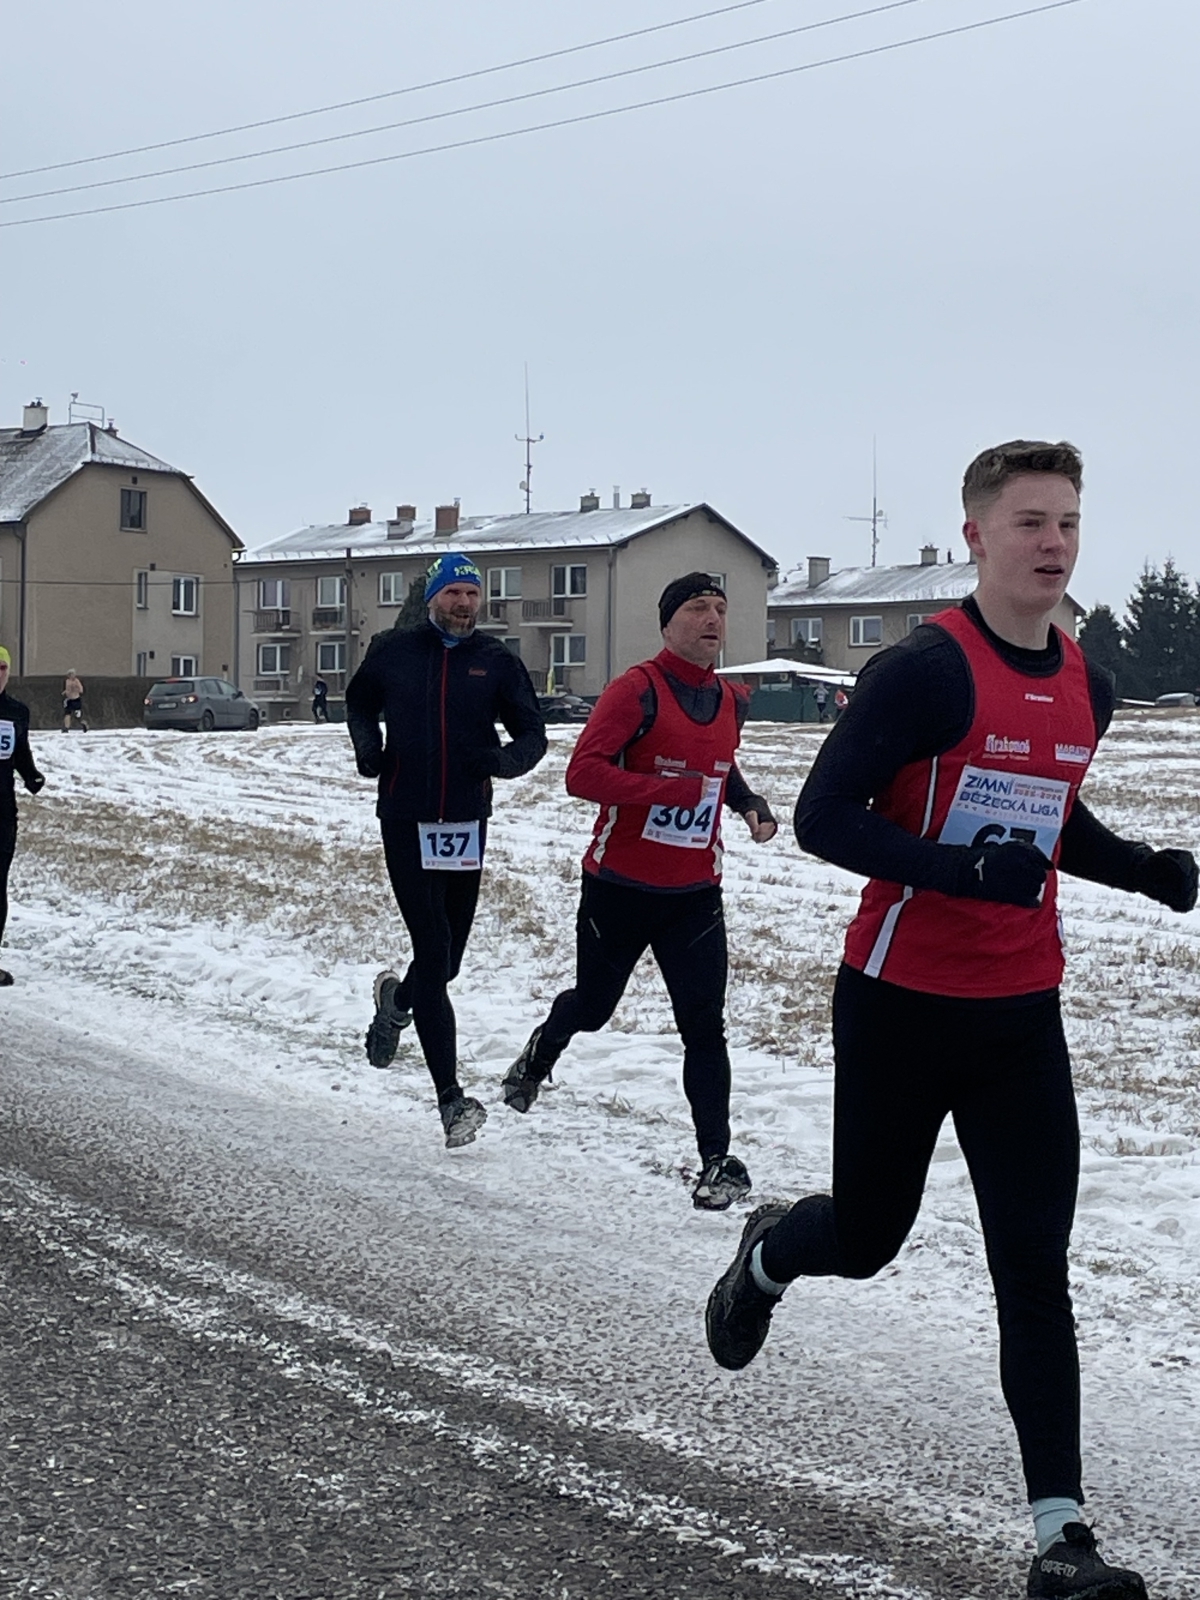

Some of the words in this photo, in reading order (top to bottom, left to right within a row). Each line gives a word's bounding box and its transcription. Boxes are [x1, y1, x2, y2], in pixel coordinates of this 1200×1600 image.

[652, 806, 712, 832] 304
[1030, 803, 1060, 818] LIGA
[426, 831, 471, 858] 137
